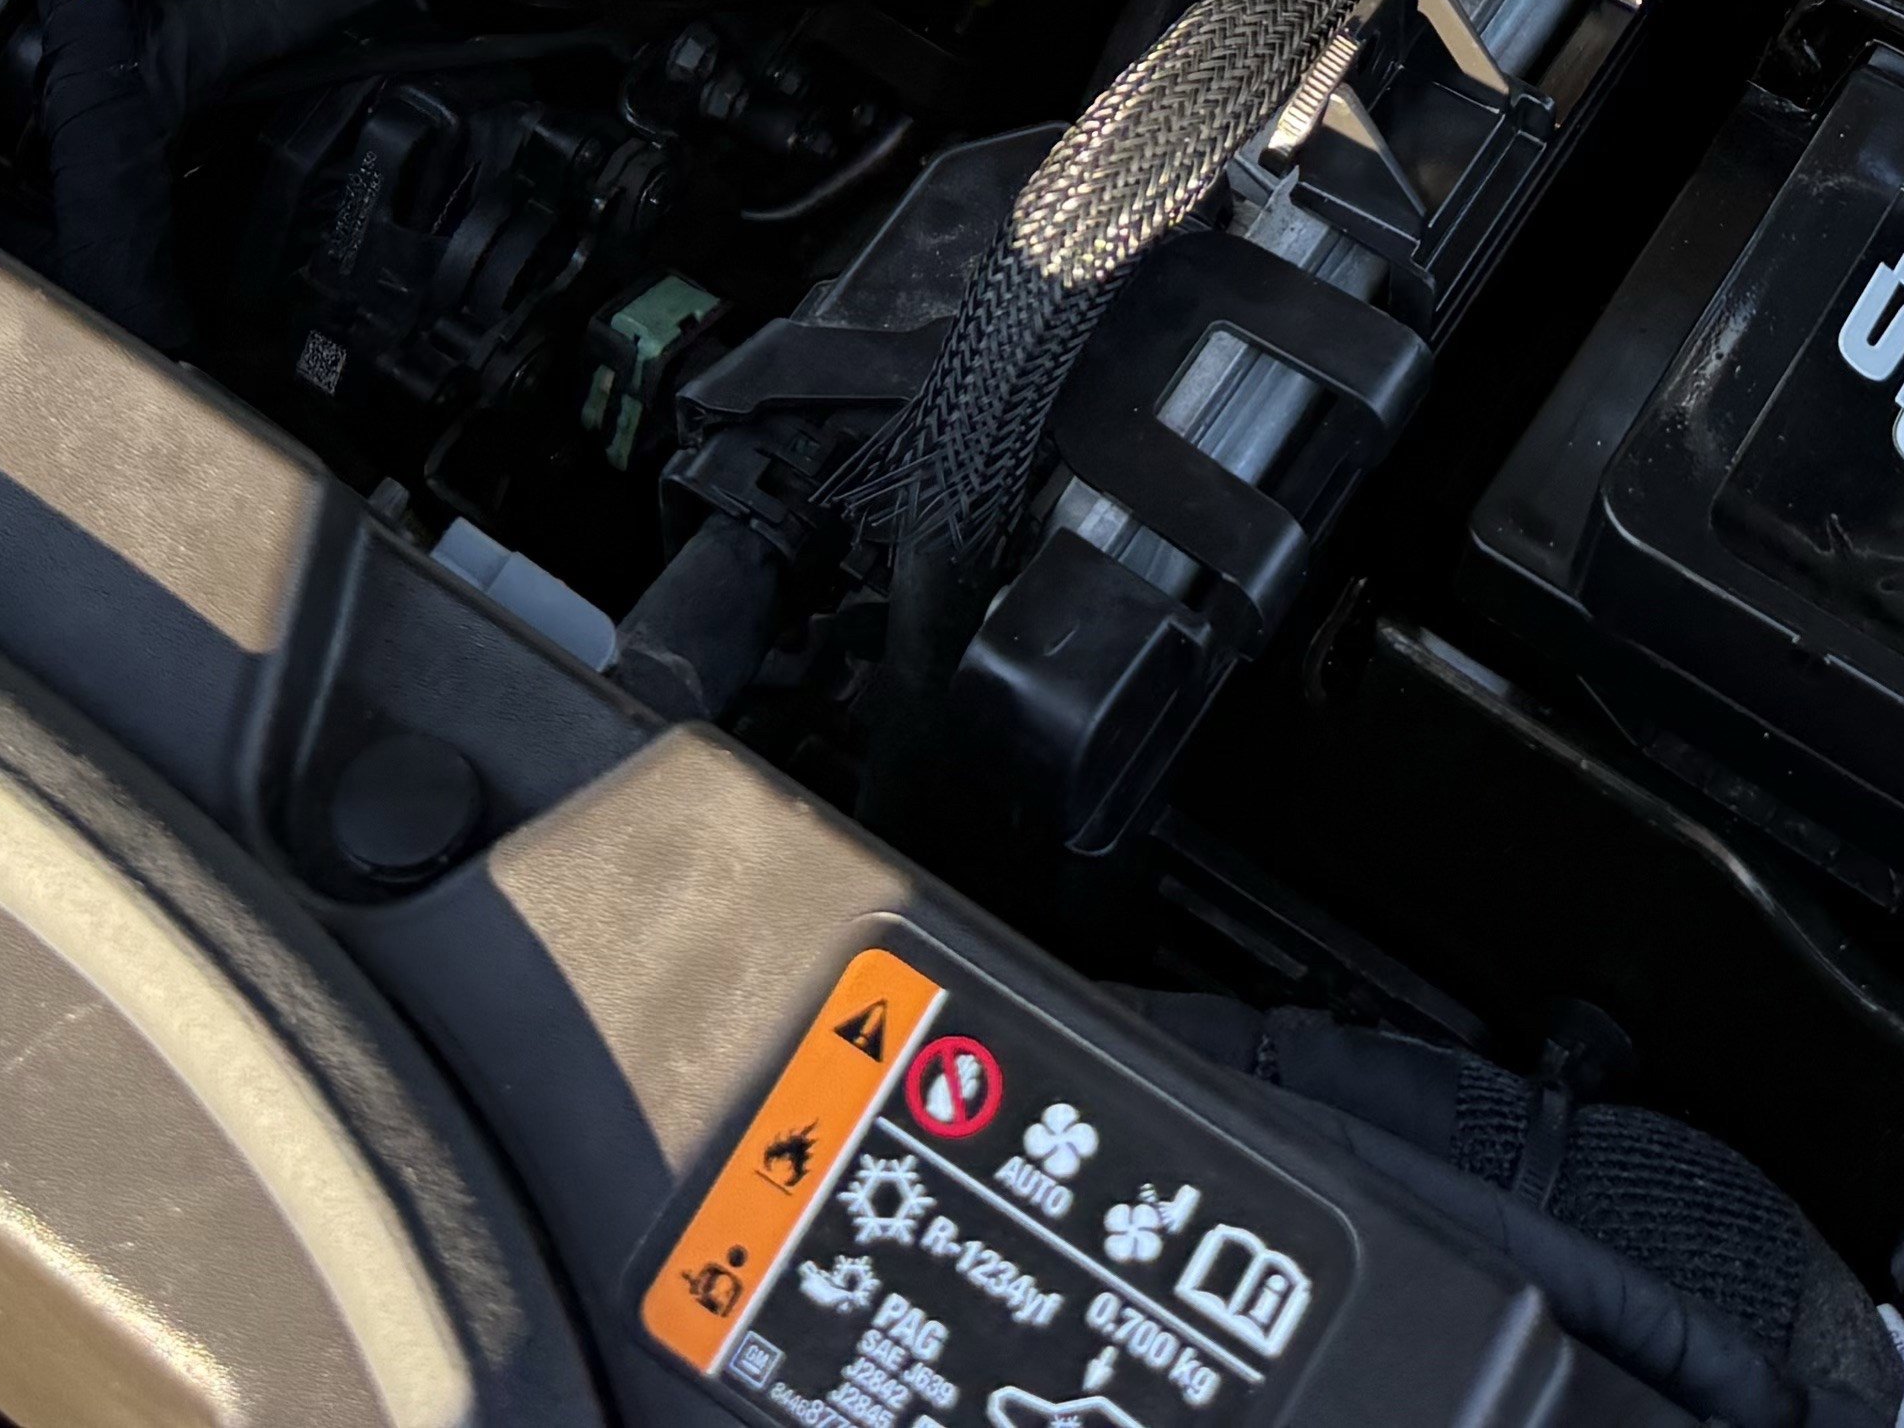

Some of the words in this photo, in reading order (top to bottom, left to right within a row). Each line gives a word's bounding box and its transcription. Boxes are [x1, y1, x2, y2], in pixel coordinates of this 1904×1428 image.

[994, 1155, 1074, 1218] AUTO
[920, 1215, 1064, 1326] R-1234yf
[745, 1344, 771, 1371] GM
[869, 1292, 949, 1361] PAG
[1086, 1291, 1189, 1368] 0.700
[1168, 1346, 1221, 1406] kg
[842, 1356, 918, 1410] J2842
[857, 1329, 907, 1372] SAE
[895, 1361, 958, 1408] J639
